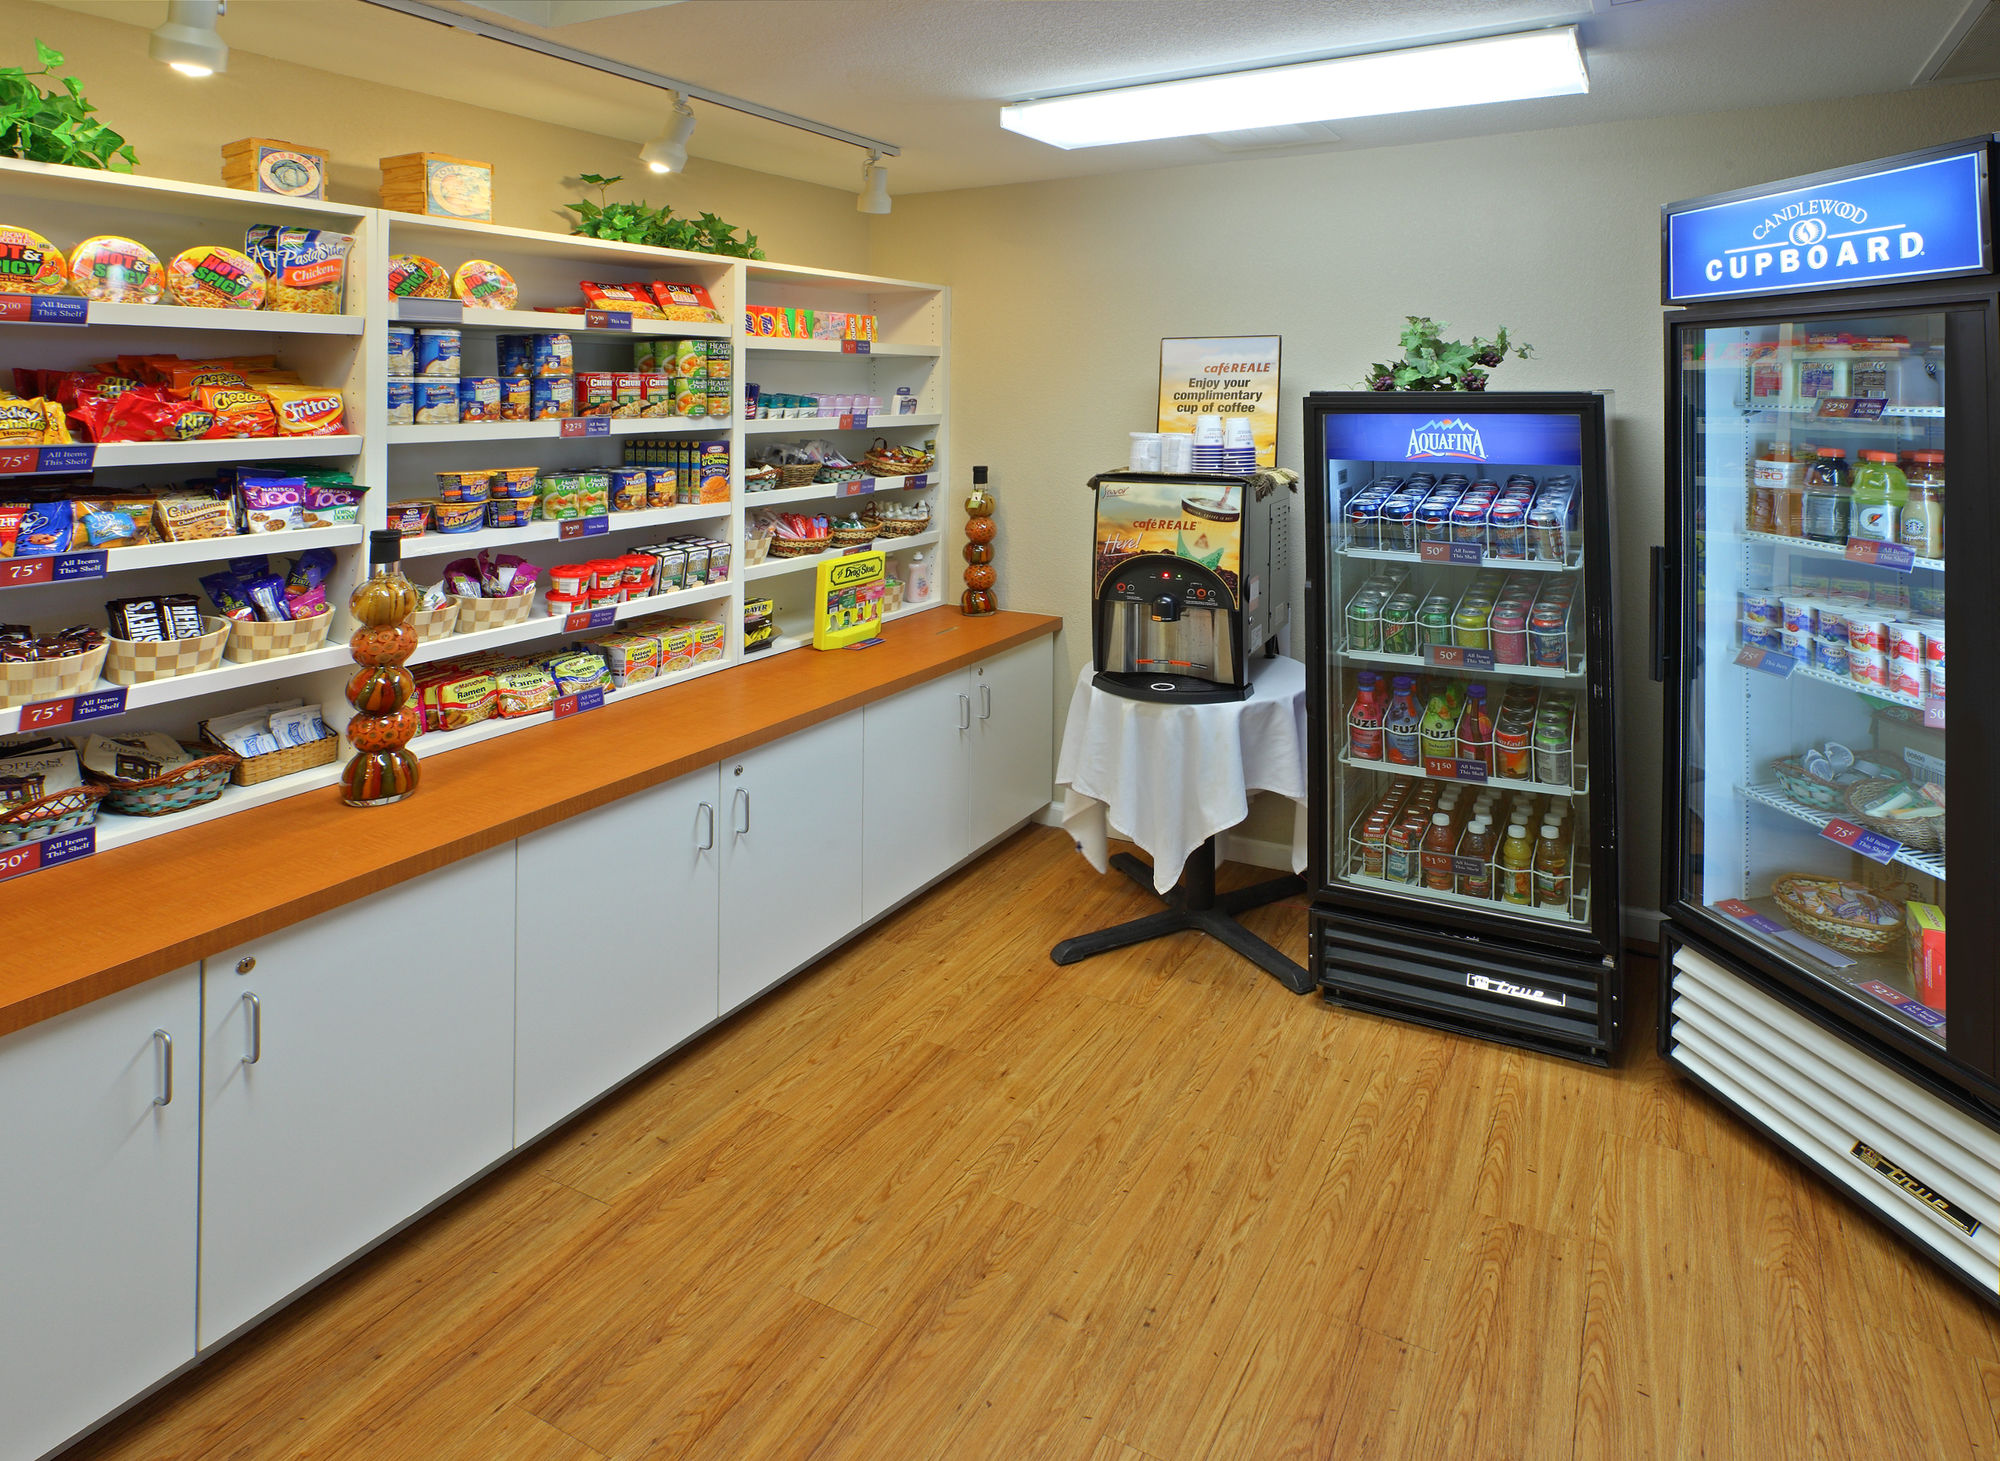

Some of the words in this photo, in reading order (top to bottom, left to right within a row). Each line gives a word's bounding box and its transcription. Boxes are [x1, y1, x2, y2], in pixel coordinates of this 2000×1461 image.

[1752, 199, 1868, 241] CANDLEWOOD
[95, 250, 137, 269] HOT
[133, 259, 150, 272] &
[276, 248, 321, 269] Pasta
[1705, 231, 1924, 282] CUPBOARD
[200, 253, 246, 280] HOT
[236, 275, 253, 288] &
[292, 264, 334, 282] Chicken
[194, 266, 248, 296] SPICY
[394, 268, 429, 297] SPICY
[40, 300, 54, 308] All
[56, 301, 81, 309] Items
[38, 308, 57, 317] This
[59, 309, 84, 318] Shelf
[760, 315, 773, 335] Tide
[1189, 377, 1220, 389] Enjoy
[1223, 379, 1251, 390] your
[1173, 390, 1263, 402] complimentary
[282, 396, 339, 423] Fritos
[1177, 404, 1198, 414] cup
[1202, 402, 1214, 413] of
[1217, 402, 1256, 413] coffee
[1405, 428, 1489, 460] AQUAFINA
[65, 457, 89, 466] Shelf
[259, 491, 300, 506] 100
[1103, 484, 1130, 499] Savor
[443, 515, 466, 527] EASY
[1133, 518, 1197, 531] caféREALE
[1104, 532, 1143, 554] Here!
[1426, 546, 1444, 555] 50¢
[10, 562, 43, 578] 75¢
[59, 567, 78, 575] This
[80, 564, 102, 573] Shelf
[61, 559, 75, 567] All
[1440, 651, 1457, 660] 50¢
[457, 685, 487, 699] Ramen
[78, 706, 98, 715] This
[99, 702, 120, 711] Shelf
[81, 699, 95, 708] All
[97, 696, 119, 704] Items
[560, 701, 575, 712] 75¢
[31, 704, 64, 722] 75¢
[1425, 729, 1455, 739] FUZE
[1430, 761, 1452, 771] $150
[1833, 826, 1854, 838] 75¢
[49, 840, 63, 851] All
[65, 836, 88, 847] Items
[46, 850, 66, 860] This
[68, 842, 91, 853] Shelf
[1425, 856, 1447, 865] $150
[1887, 1168, 1950, 1211] true
